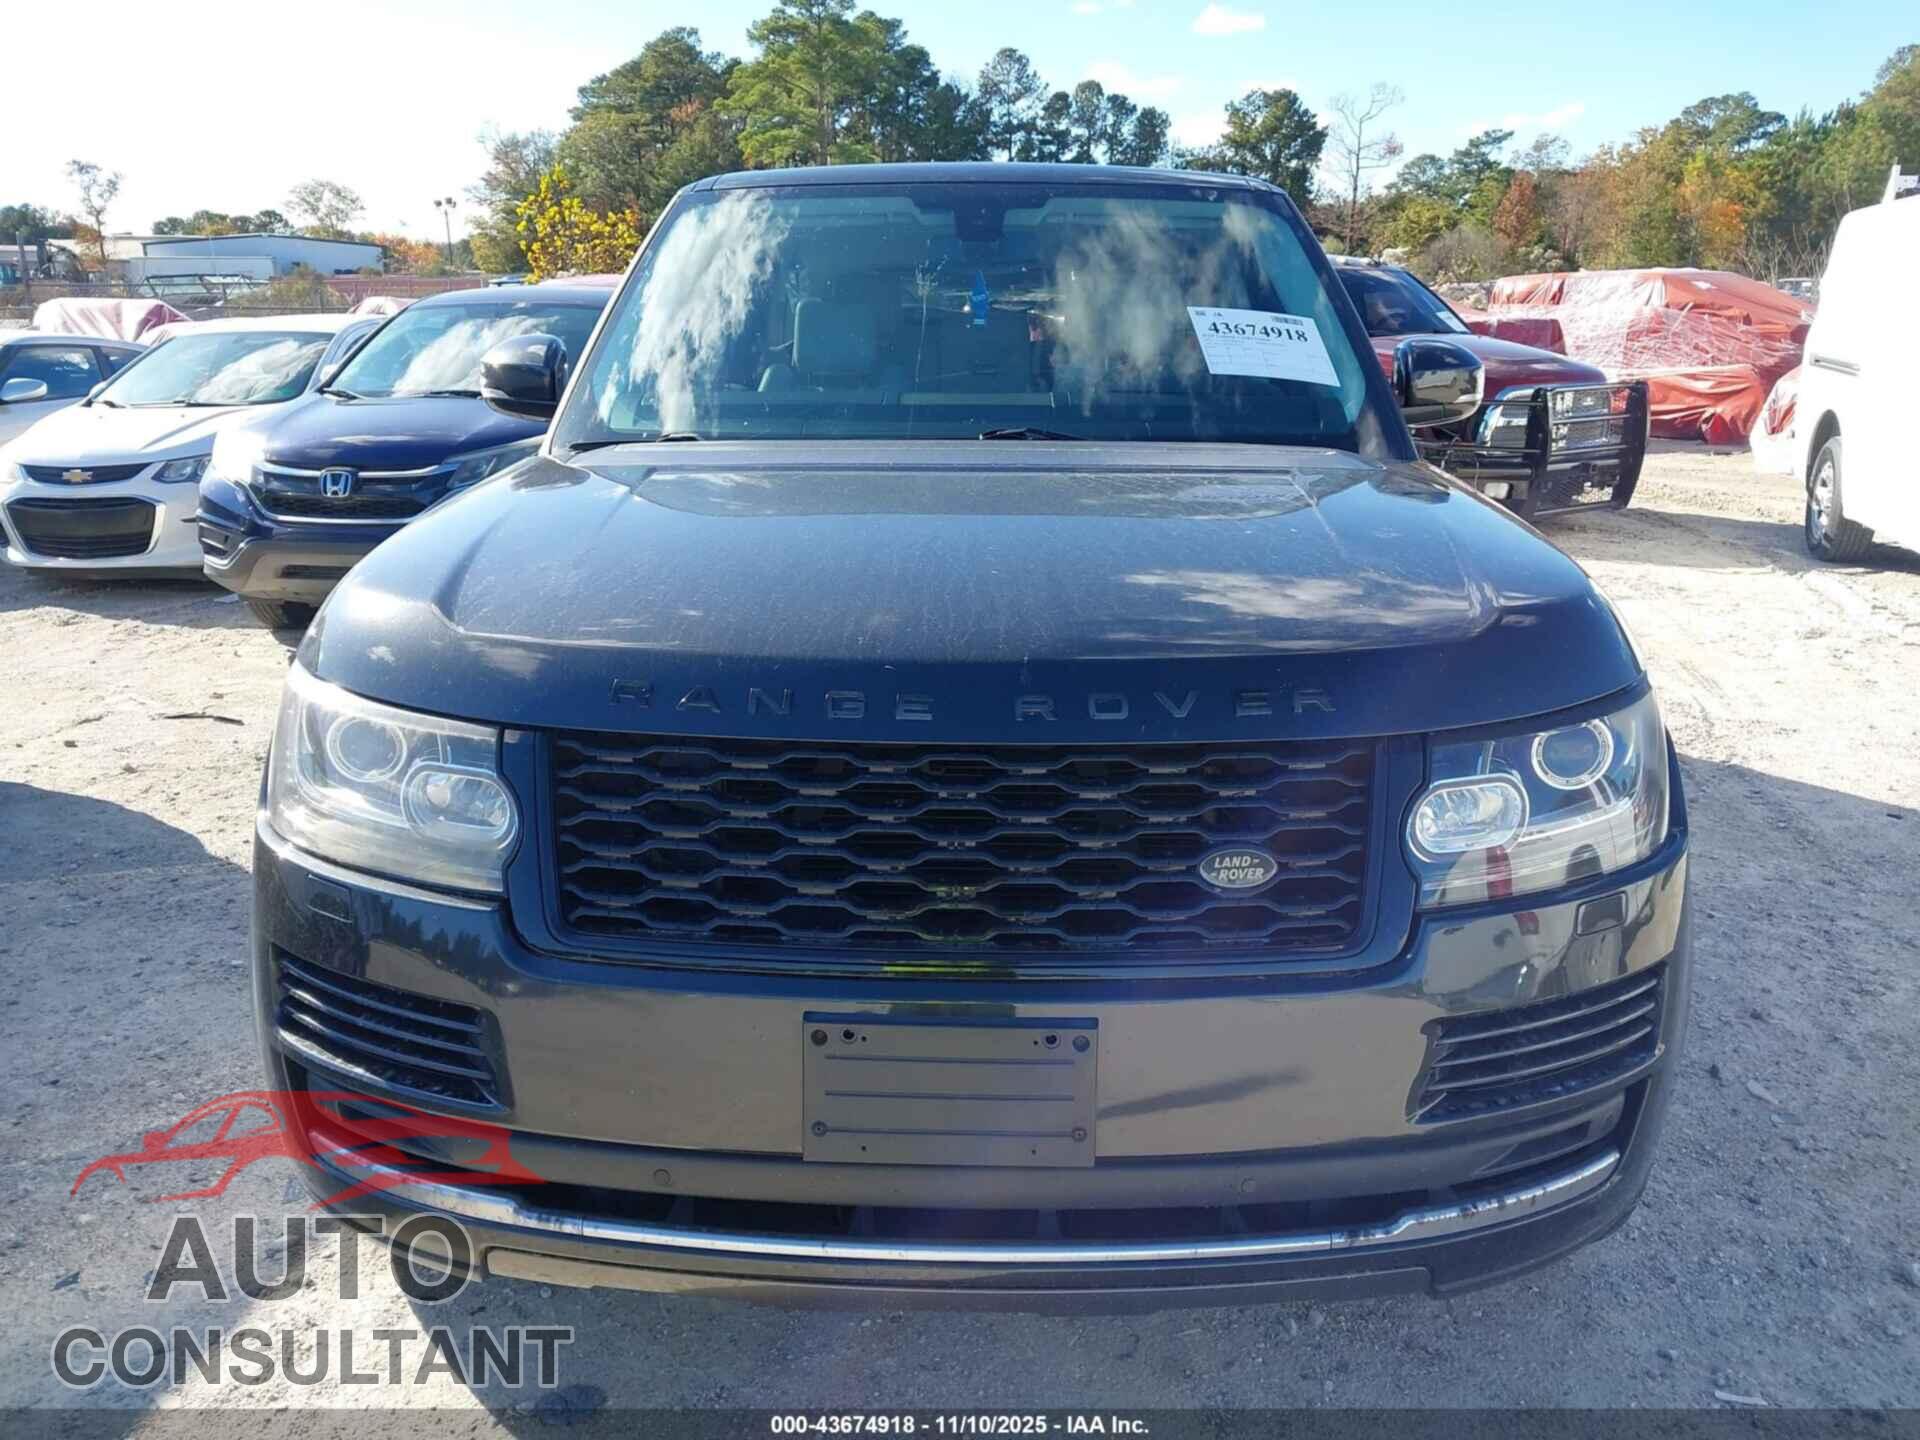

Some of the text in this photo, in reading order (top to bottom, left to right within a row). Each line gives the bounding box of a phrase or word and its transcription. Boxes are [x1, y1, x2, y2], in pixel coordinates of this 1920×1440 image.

[1208, 321, 1309, 343] 43674918
[608, 678, 1337, 721] RANGE ROVER
